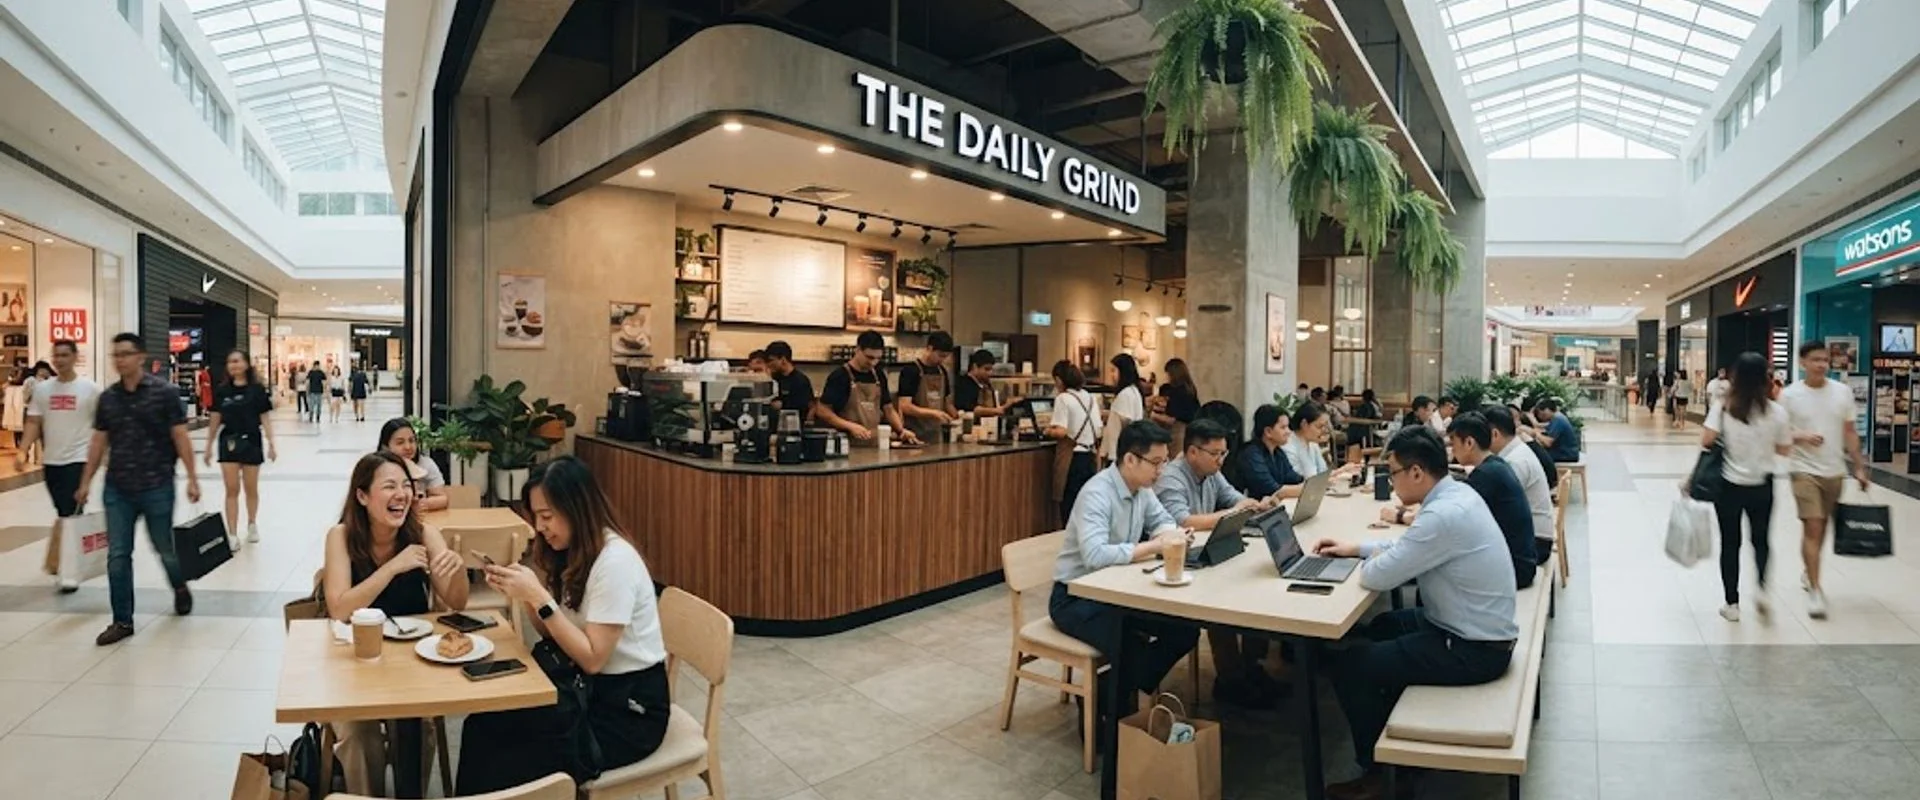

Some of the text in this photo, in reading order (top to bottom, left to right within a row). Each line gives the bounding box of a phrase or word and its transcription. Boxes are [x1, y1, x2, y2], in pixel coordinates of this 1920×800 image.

[856, 72, 1141, 214] THE DAILY GRIND
[1844, 219, 1912, 260] watsons
